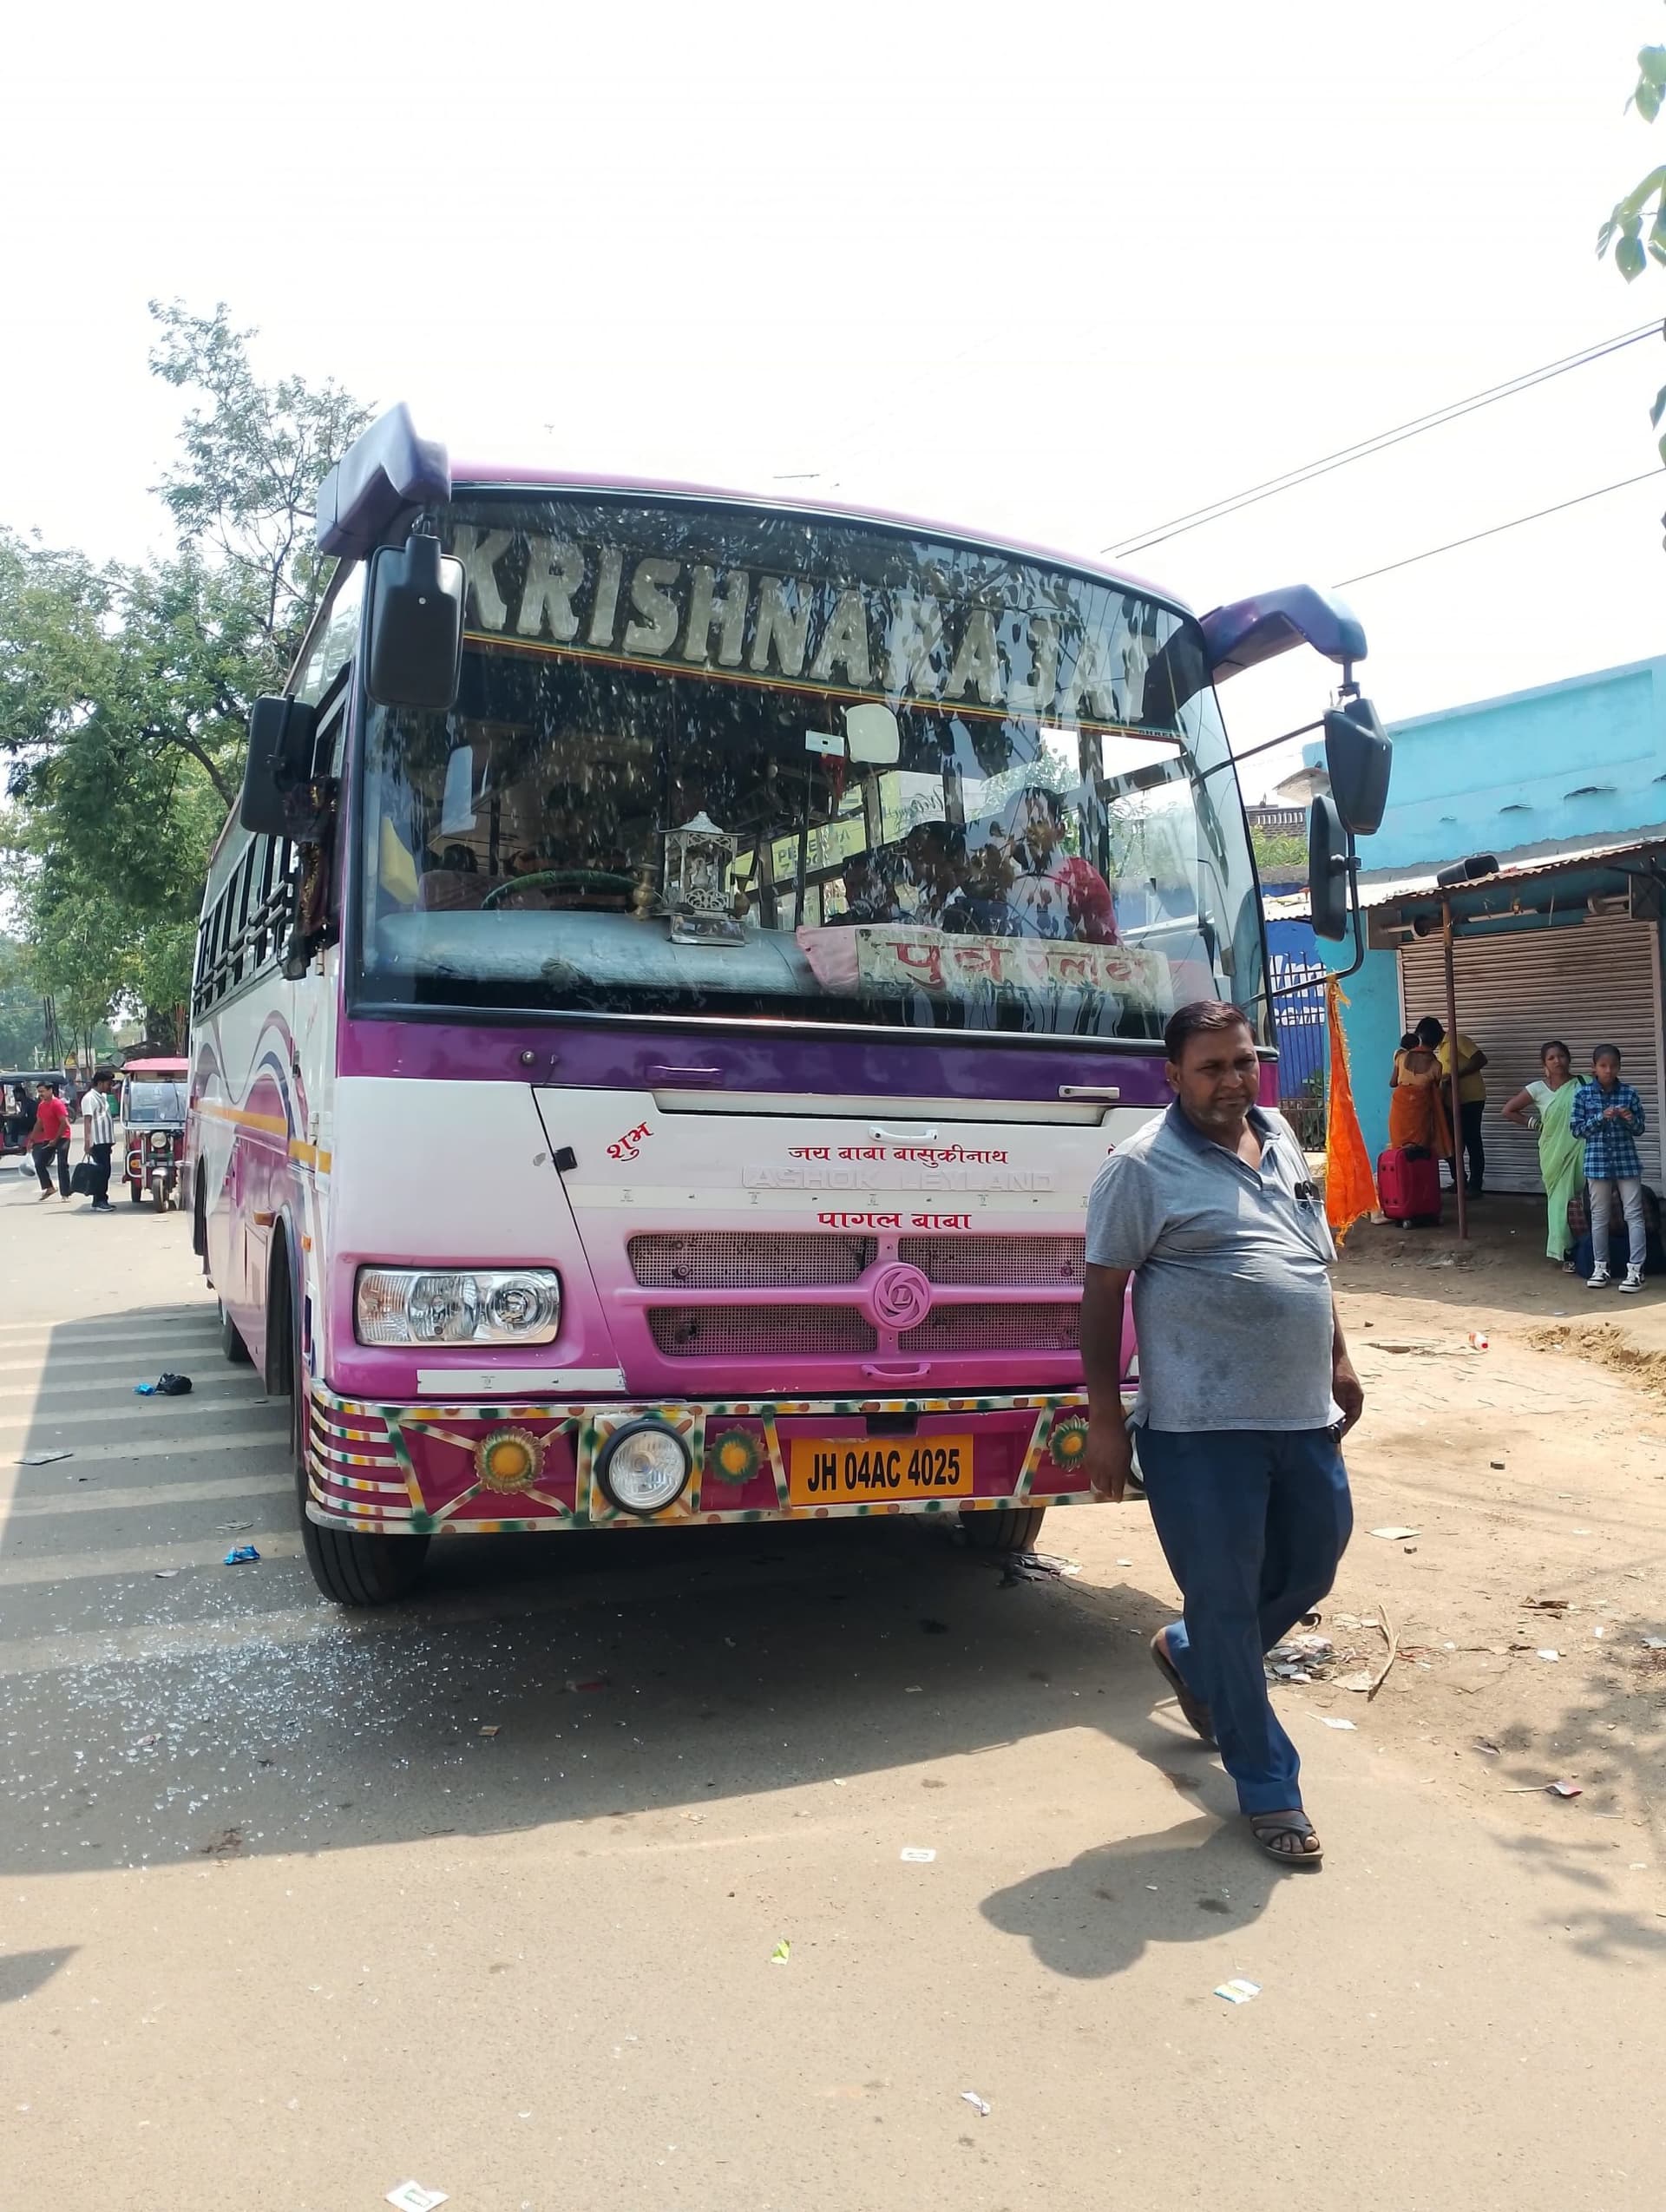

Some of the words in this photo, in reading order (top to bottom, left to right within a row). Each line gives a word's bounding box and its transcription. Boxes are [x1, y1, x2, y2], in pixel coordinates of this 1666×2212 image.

[453, 524, 873, 686] KRISHNA
[606, 1120, 655, 1162] शुभ
[787, 1146, 831, 1161] जय
[838, 1146, 887, 1161] बाबा
[893, 1144, 1009, 1168] बासुकीनाथ
[750, 1165, 878, 1190] ASHOK
[900, 1168, 1055, 1192] LEYLAND
[817, 1211, 903, 1230] पागल
[910, 1213, 973, 1231] बाबा
[807, 1453, 836, 1492] JH
[844, 1449, 901, 1490] 04AC
[908, 1447, 960, 1487] 4025
